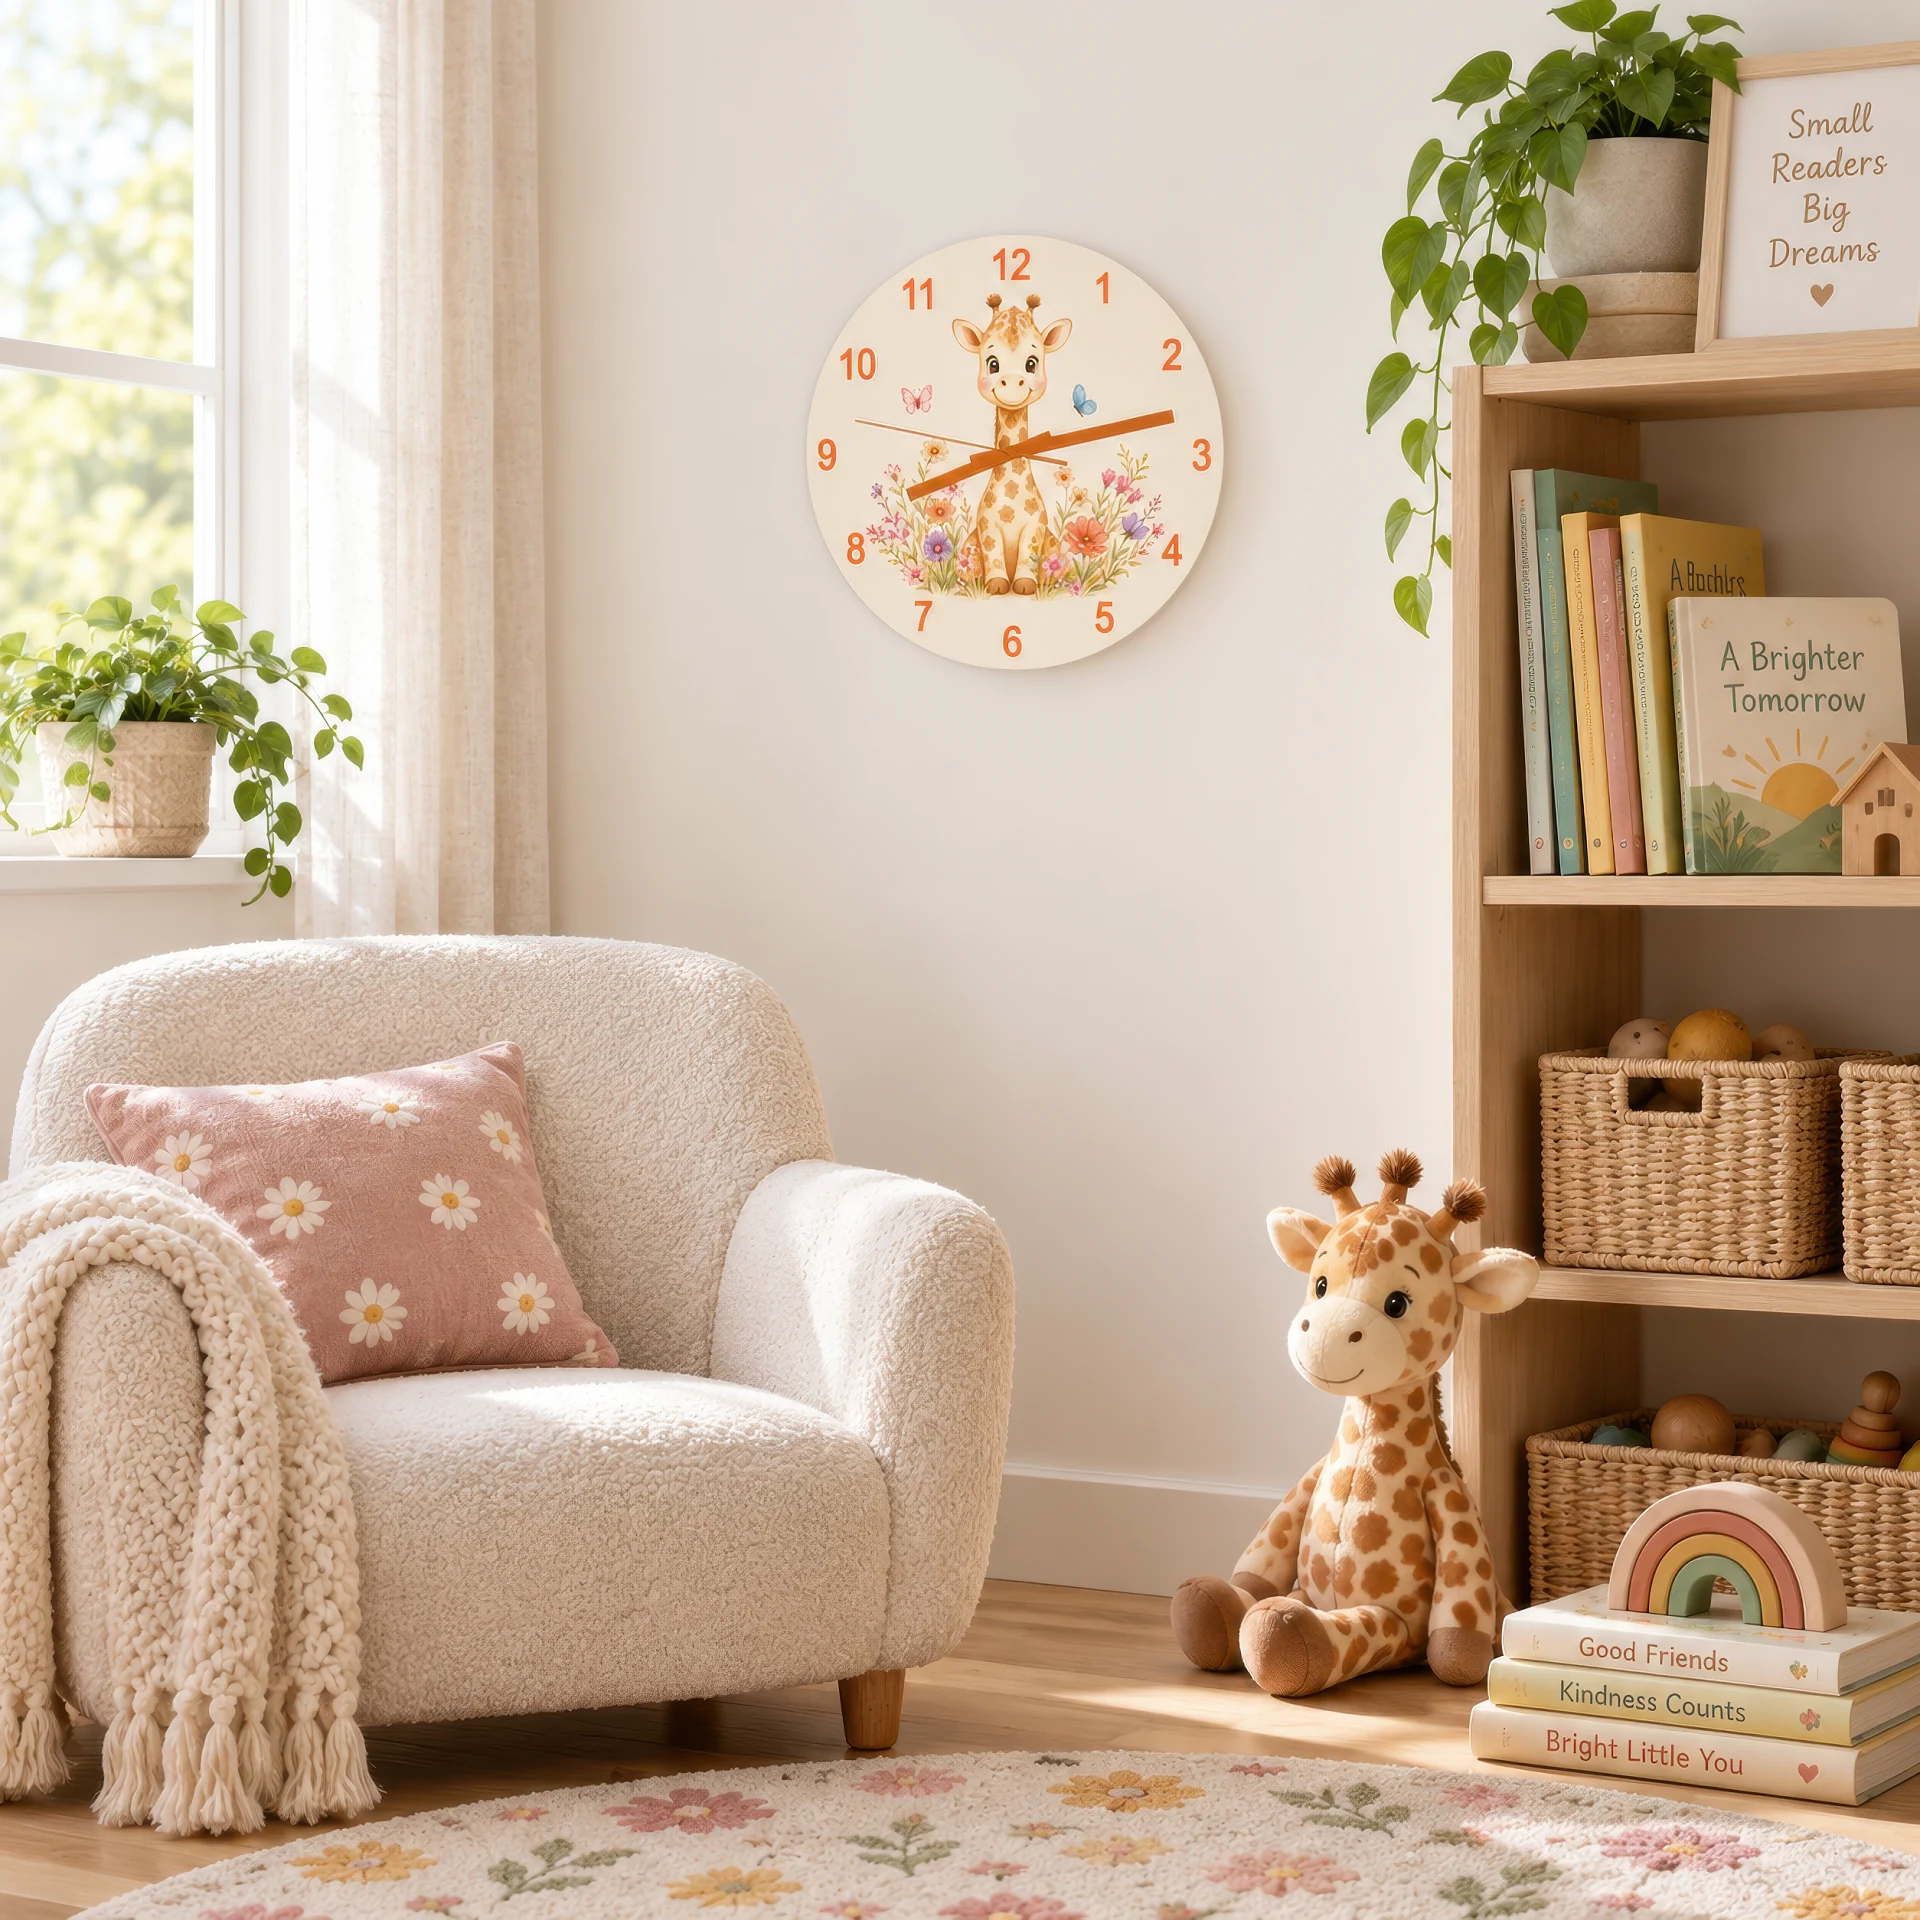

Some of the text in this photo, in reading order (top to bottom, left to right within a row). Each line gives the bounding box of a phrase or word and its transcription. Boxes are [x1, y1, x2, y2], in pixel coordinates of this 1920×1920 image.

[1788, 101, 1874, 139] Small
[1771, 146, 1888, 184] Readers
[1802, 193, 1851, 233] Big
[992, 248, 1031, 281] 12
[1768, 238, 1880, 268] Dreams
[902, 278, 933, 310] 11
[1095, 272, 1109, 304] 1
[839, 347, 877, 380] 10
[1161, 338, 1183, 371] 2
[817, 438, 837, 471] 9
[1192, 438, 1212, 472] 3
[847, 532, 866, 565] 8
[1161, 533, 1183, 566] 4
[1671, 558, 1684, 591] A
[914, 601, 933, 632] 7
[1095, 601, 1115, 634] 5
[1002, 625, 1023, 658] 6
[1720, 639, 1865, 682] A Brighter
[1723, 683, 1866, 713] Tomorrow
[1579, 1636, 1729, 1673] Good Friends
[1560, 1680, 1657, 1711] Kindness
[1665, 1693, 1746, 1723] Counts
[1546, 1729, 1744, 1776] Bright Little You
